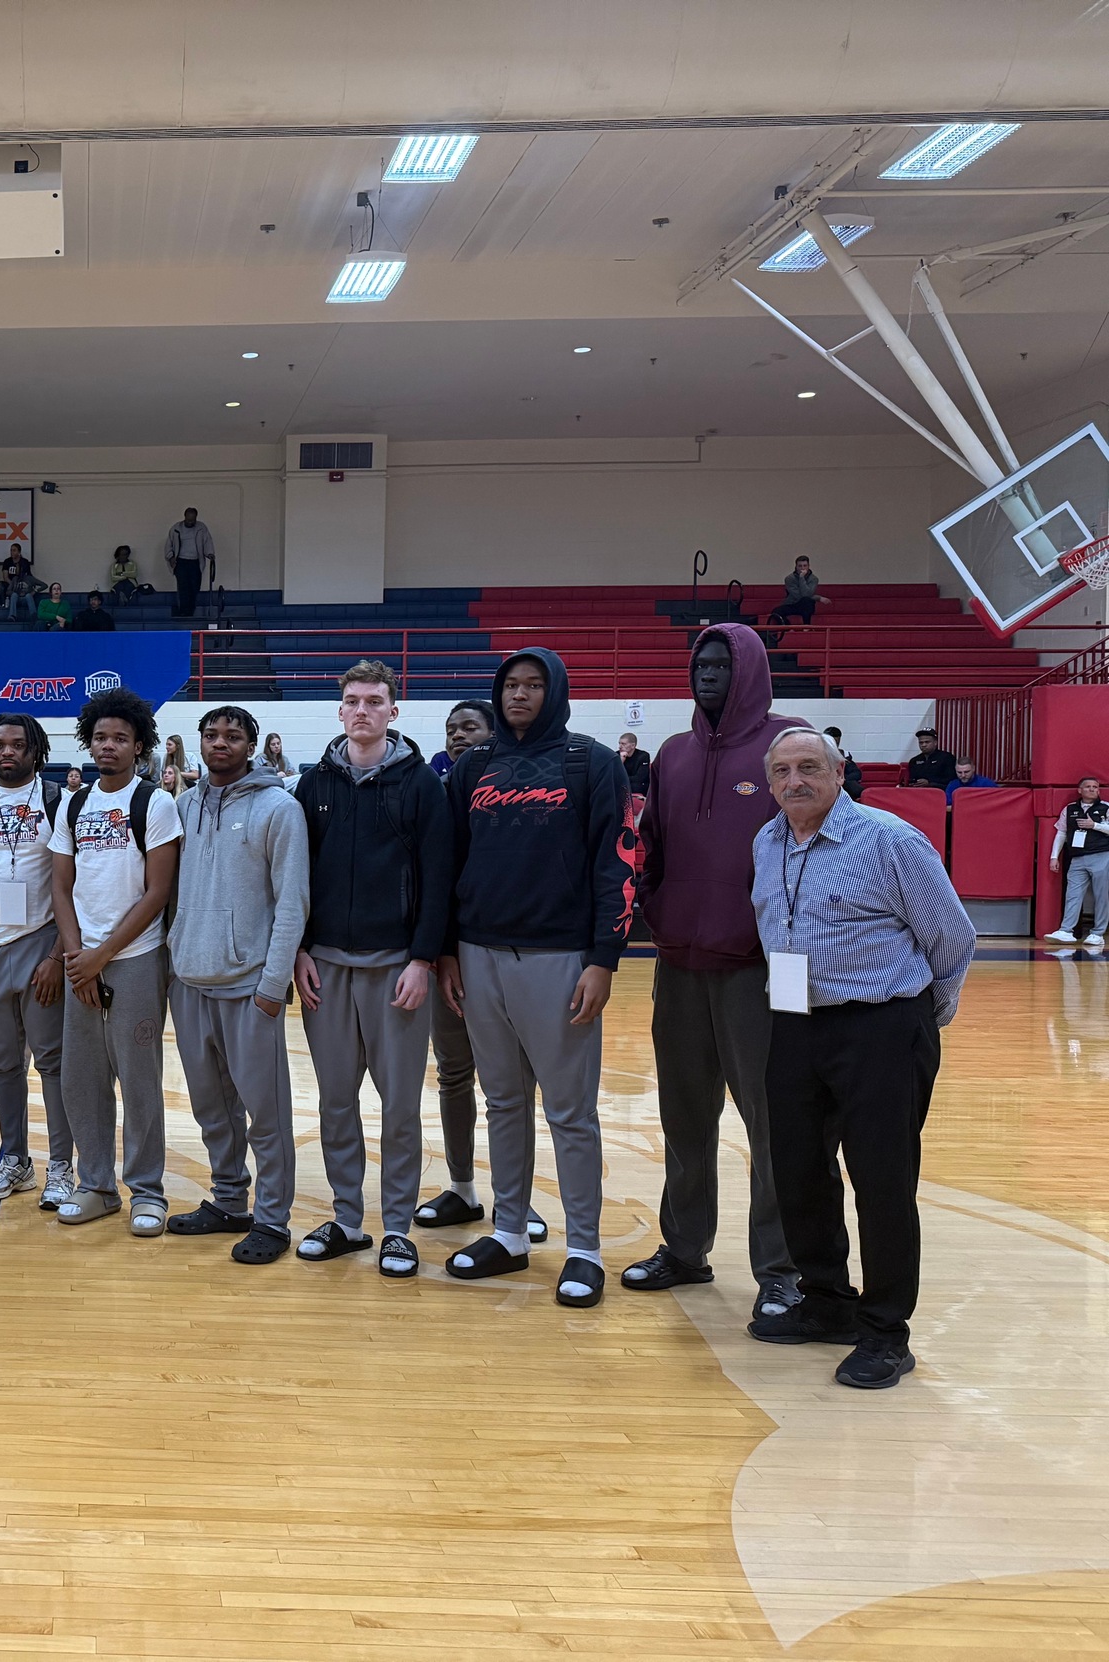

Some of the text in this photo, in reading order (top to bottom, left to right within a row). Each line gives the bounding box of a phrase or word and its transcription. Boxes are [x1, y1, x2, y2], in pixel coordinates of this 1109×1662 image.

[8, 680, 71, 701] TCCAA
[85, 676, 120, 694] NJCAA
[382, 1245, 413, 1256] adidas
